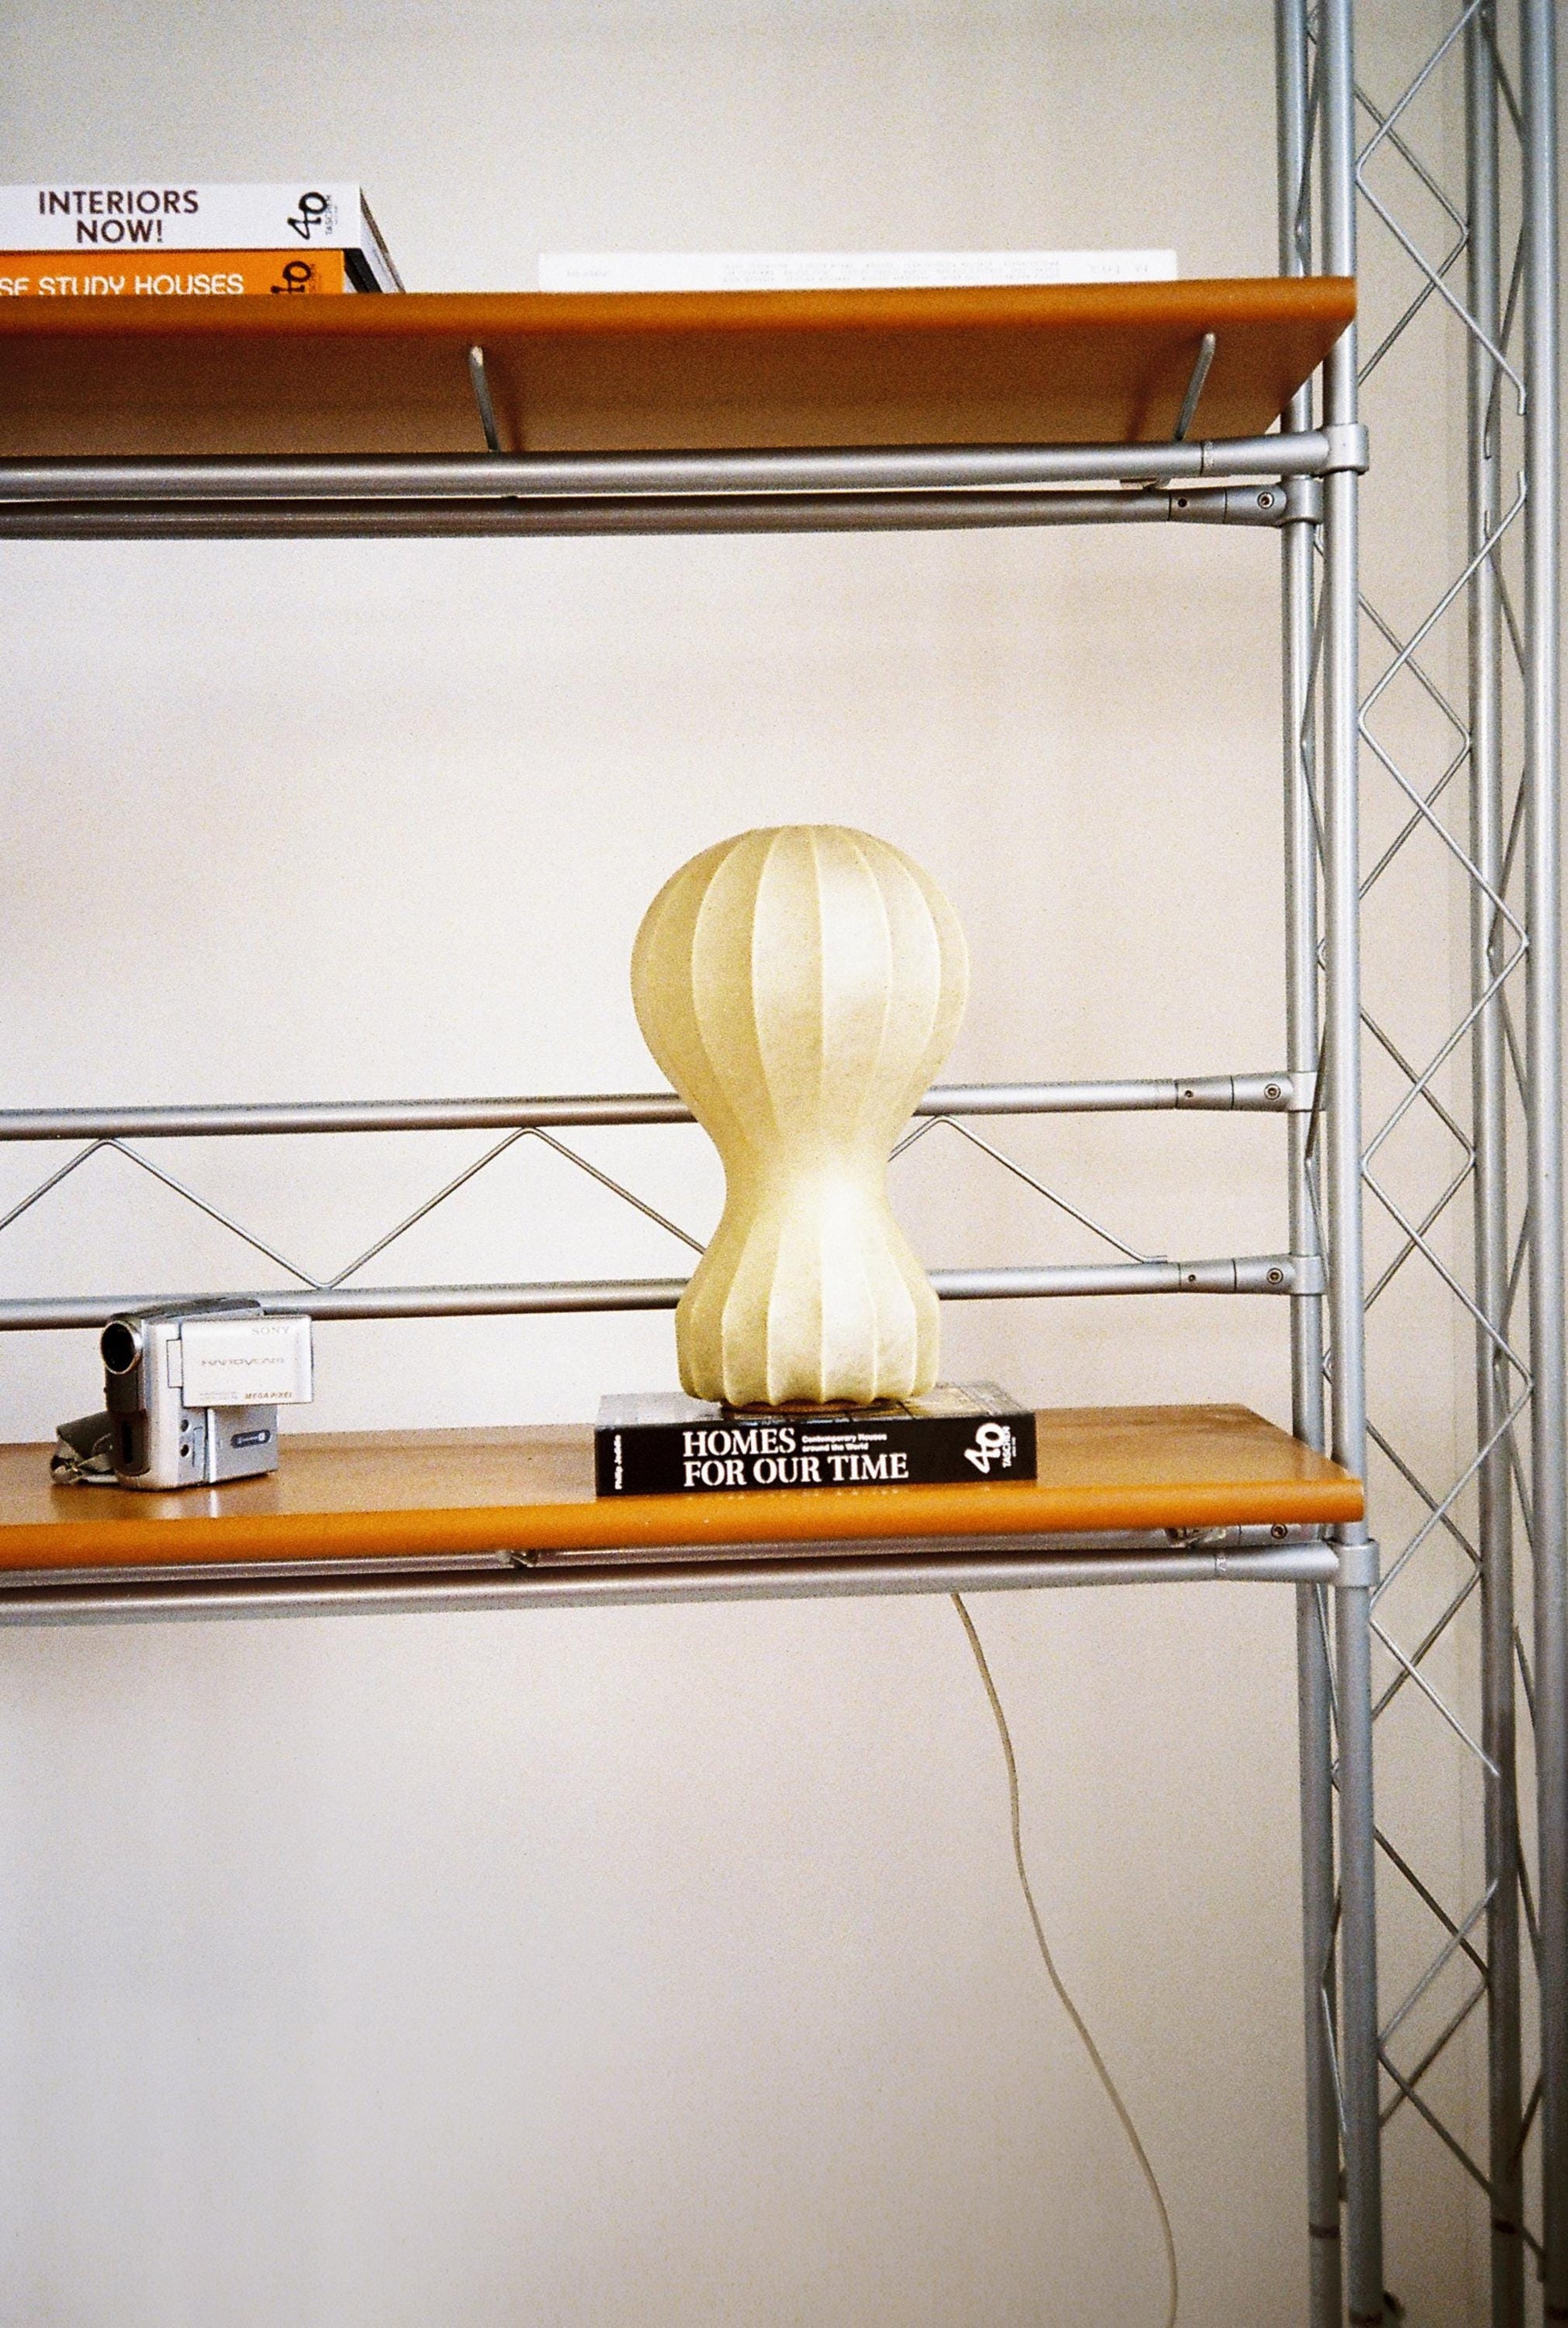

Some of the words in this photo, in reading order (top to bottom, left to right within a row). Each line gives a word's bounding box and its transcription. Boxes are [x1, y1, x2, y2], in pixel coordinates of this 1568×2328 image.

[39, 190, 199, 215] INTERIORS
[288, 192, 327, 240] 40
[76, 219, 163, 243] NOW!
[38, 276, 125, 295] STUDY
[134, 273, 243, 295] HOUSES
[251, 1326, 290, 1335] SONY
[682, 1427, 796, 1457] HOMES
[964, 1422, 1005, 1474] 40
[683, 1459, 747, 1487] FOR
[753, 1456, 821, 1484] OUR
[827, 1452, 910, 1481] TIME
